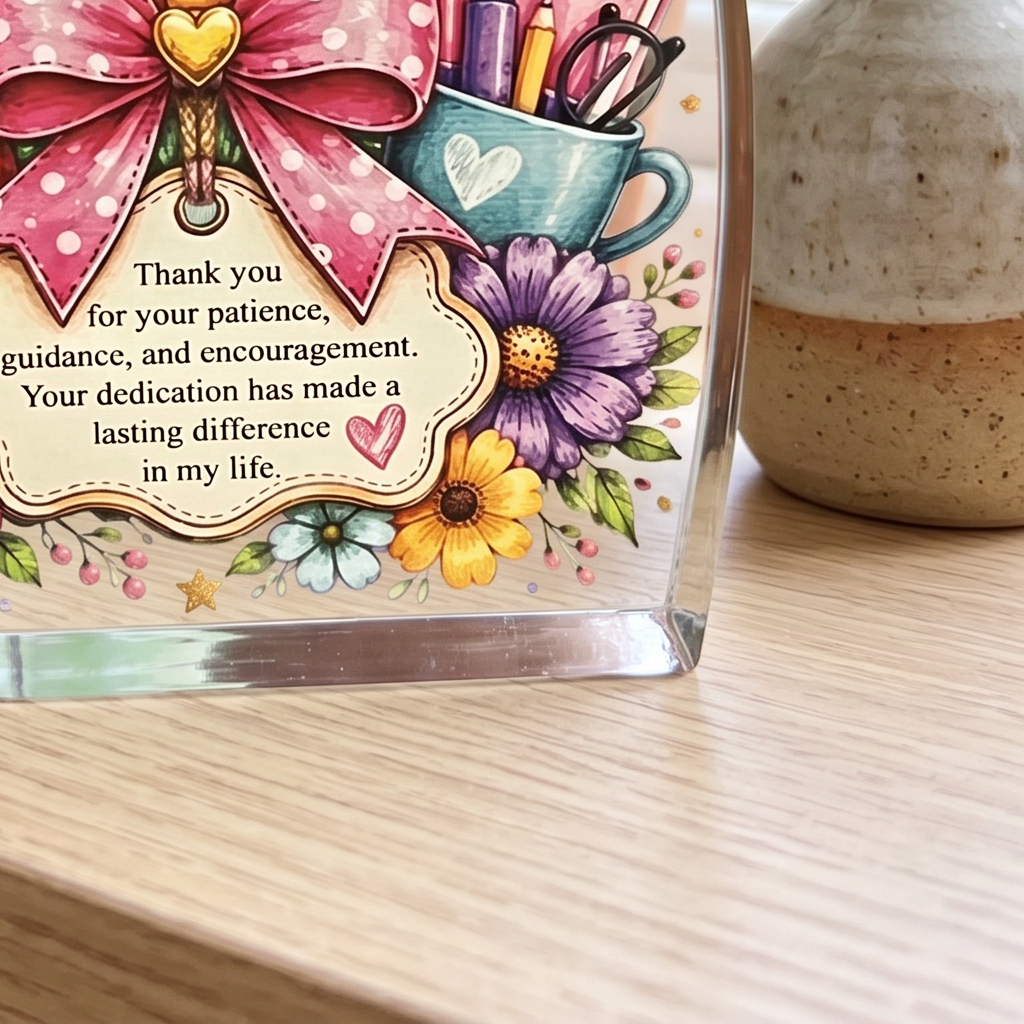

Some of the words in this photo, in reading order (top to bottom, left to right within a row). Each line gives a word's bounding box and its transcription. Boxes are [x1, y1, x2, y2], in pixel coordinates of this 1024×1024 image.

[134, 261, 220, 285] Thank
[230, 266, 281, 289] you
[88, 304, 127, 326] for
[136, 308, 199, 332] your
[208, 299, 329, 330] patience,
[1, 345, 132, 375] guidance,
[142, 341, 190, 365] and
[200, 337, 418, 367] encouragement.
[21, 384, 88, 407] Your
[97, 379, 238, 405] dedication
[248, 378, 294, 401] has
[303, 375, 376, 399] made
[387, 381, 401, 397] a
[94, 420, 183, 448] lasting
[193, 417, 330, 441] difference
[143, 458, 167, 482] in
[178, 465, 218, 486] my
[231, 456, 281, 479] life.
